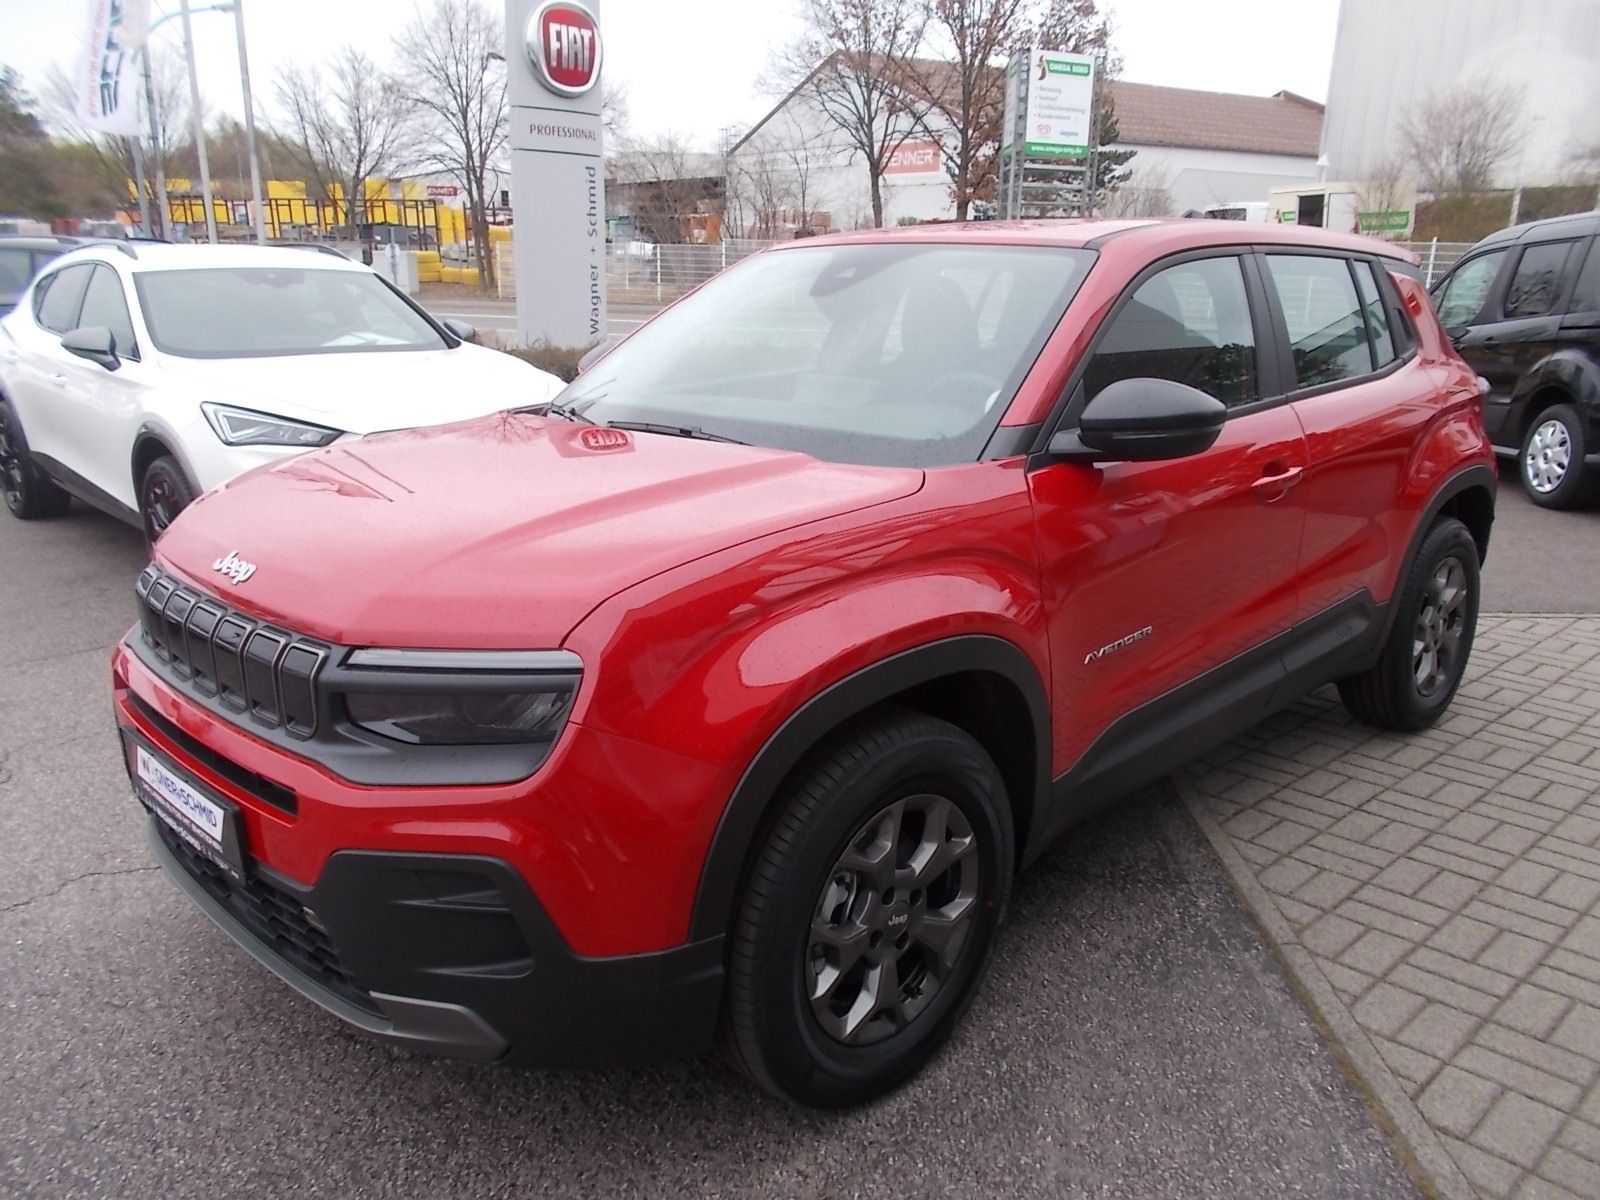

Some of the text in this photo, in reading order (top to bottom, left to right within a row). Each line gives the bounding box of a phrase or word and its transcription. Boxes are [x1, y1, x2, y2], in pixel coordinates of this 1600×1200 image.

[549, 22, 593, 72] FIAT
[529, 123, 597, 141] PROFESSIONAL
[587, 165, 597, 237] Schmid
[589, 264, 601, 335] Wagner
[212, 550, 257, 585] Jeep
[1084, 625, 1152, 665] AVENGER
[887, 913, 909, 926] Jeep
